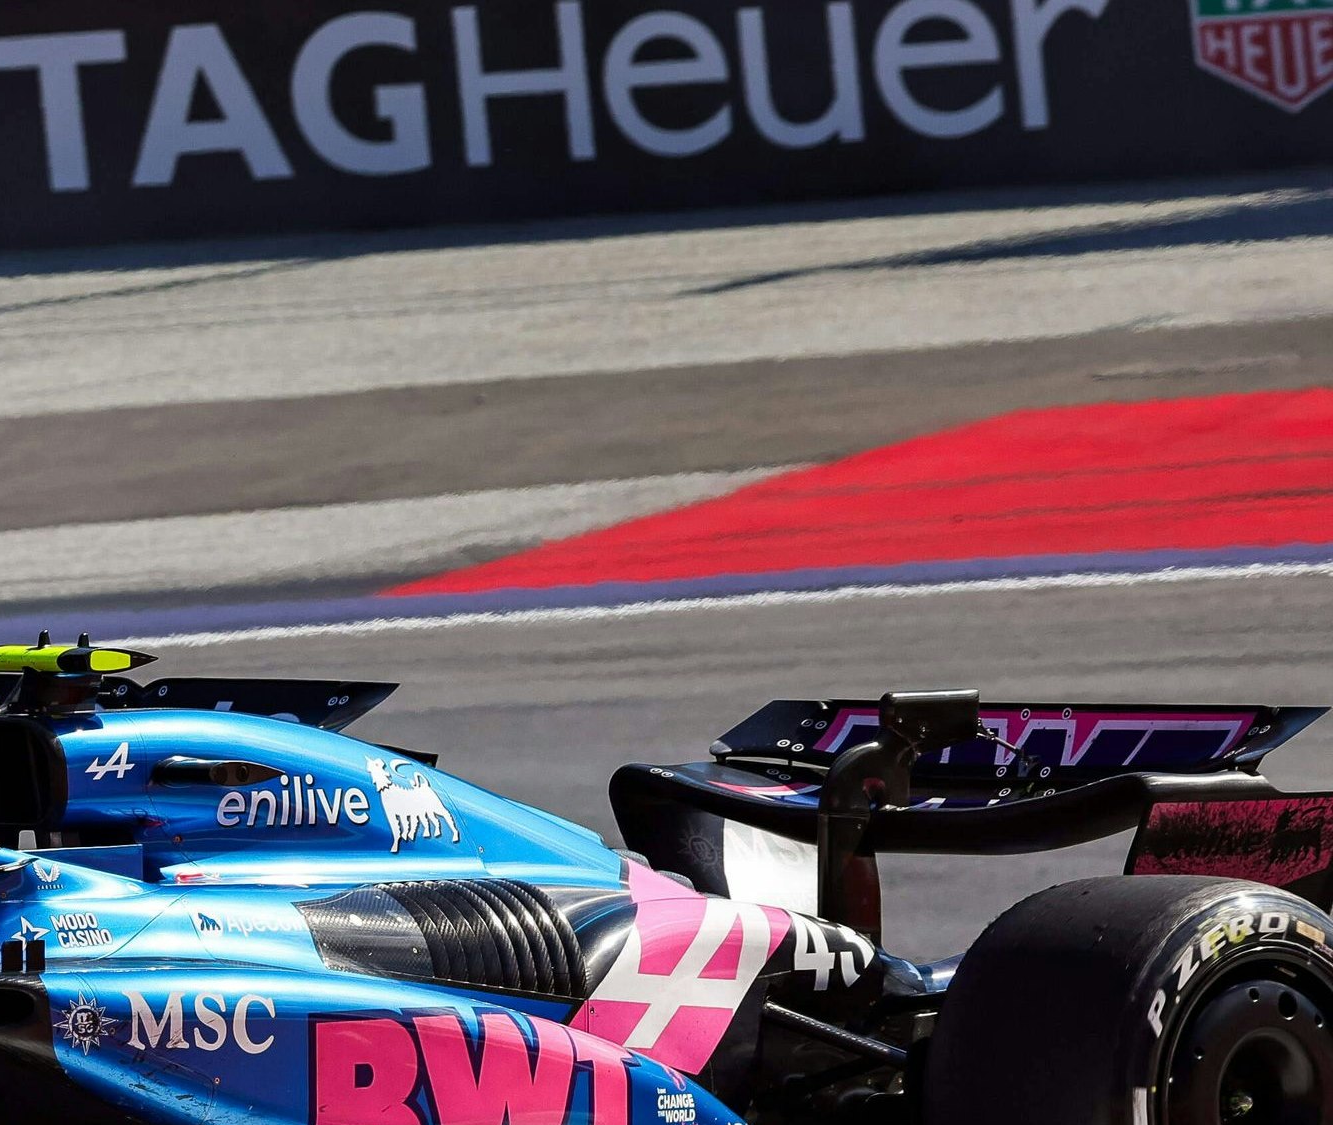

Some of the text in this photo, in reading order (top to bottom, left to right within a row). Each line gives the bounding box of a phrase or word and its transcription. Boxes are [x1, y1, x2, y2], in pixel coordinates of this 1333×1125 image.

[1205, 19, 1333, 98] HEUE
[216, 774, 371, 828] enilive
[50, 912, 98, 932] MODO
[58, 928, 113, 949] CASINO
[1171, 911, 1290, 991] ZERO
[122, 991, 277, 1054] MSC
[657, 1093, 696, 1109] CHANGE
[665, 1109, 696, 1123] WORLD
